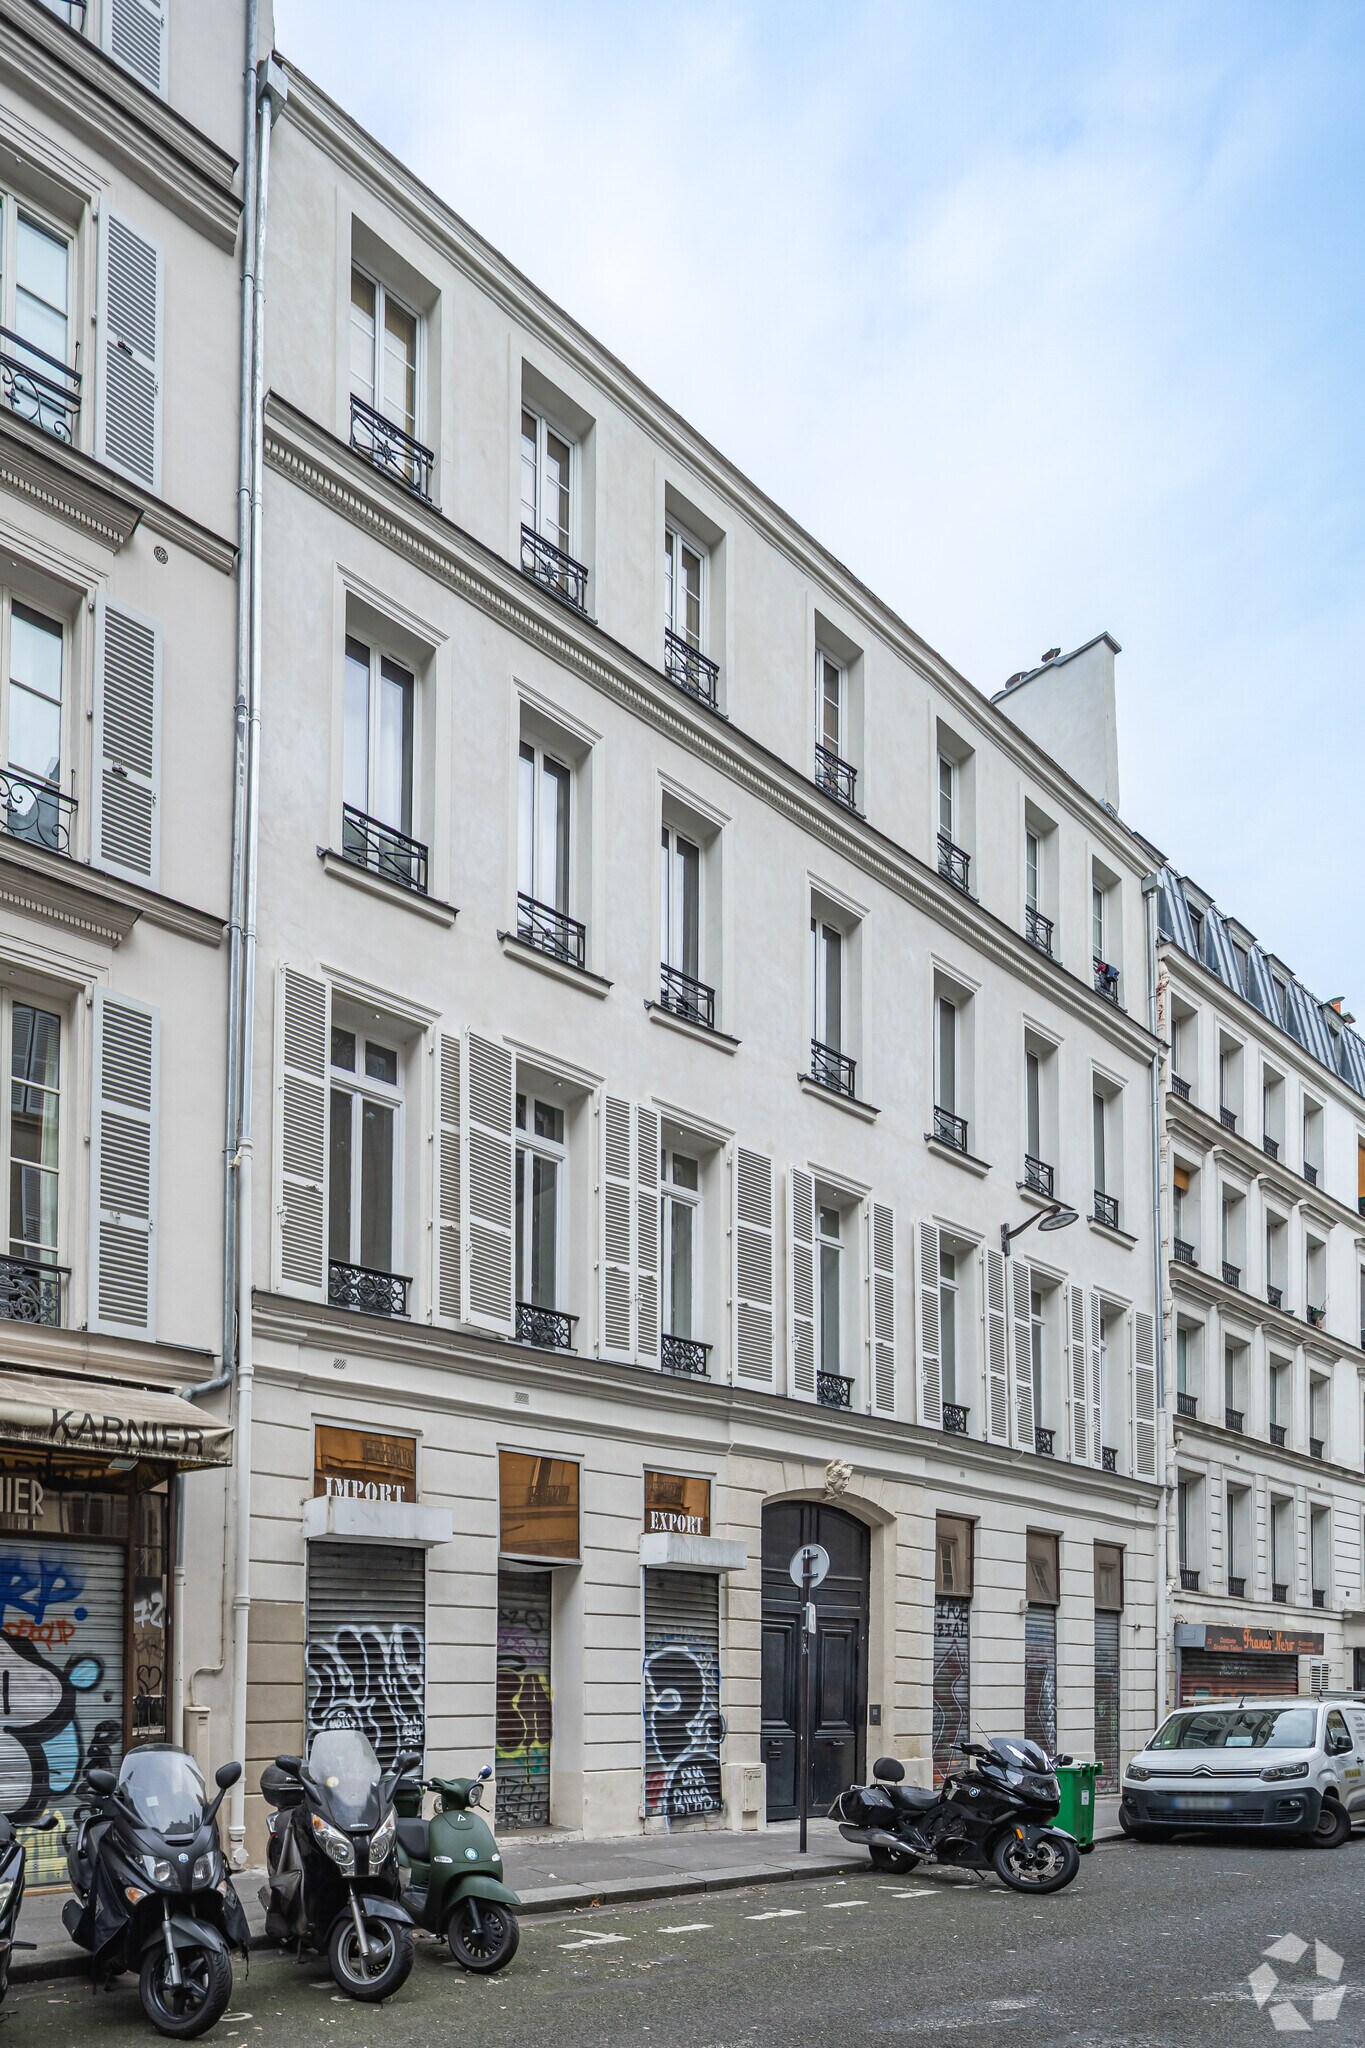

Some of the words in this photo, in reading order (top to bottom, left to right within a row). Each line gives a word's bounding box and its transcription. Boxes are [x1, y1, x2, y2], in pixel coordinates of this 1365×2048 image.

[51, 1408, 204, 1455] KARNIER
[325, 1477, 405, 1503] IMPORT
[650, 1511, 703, 1534] EXPORT
